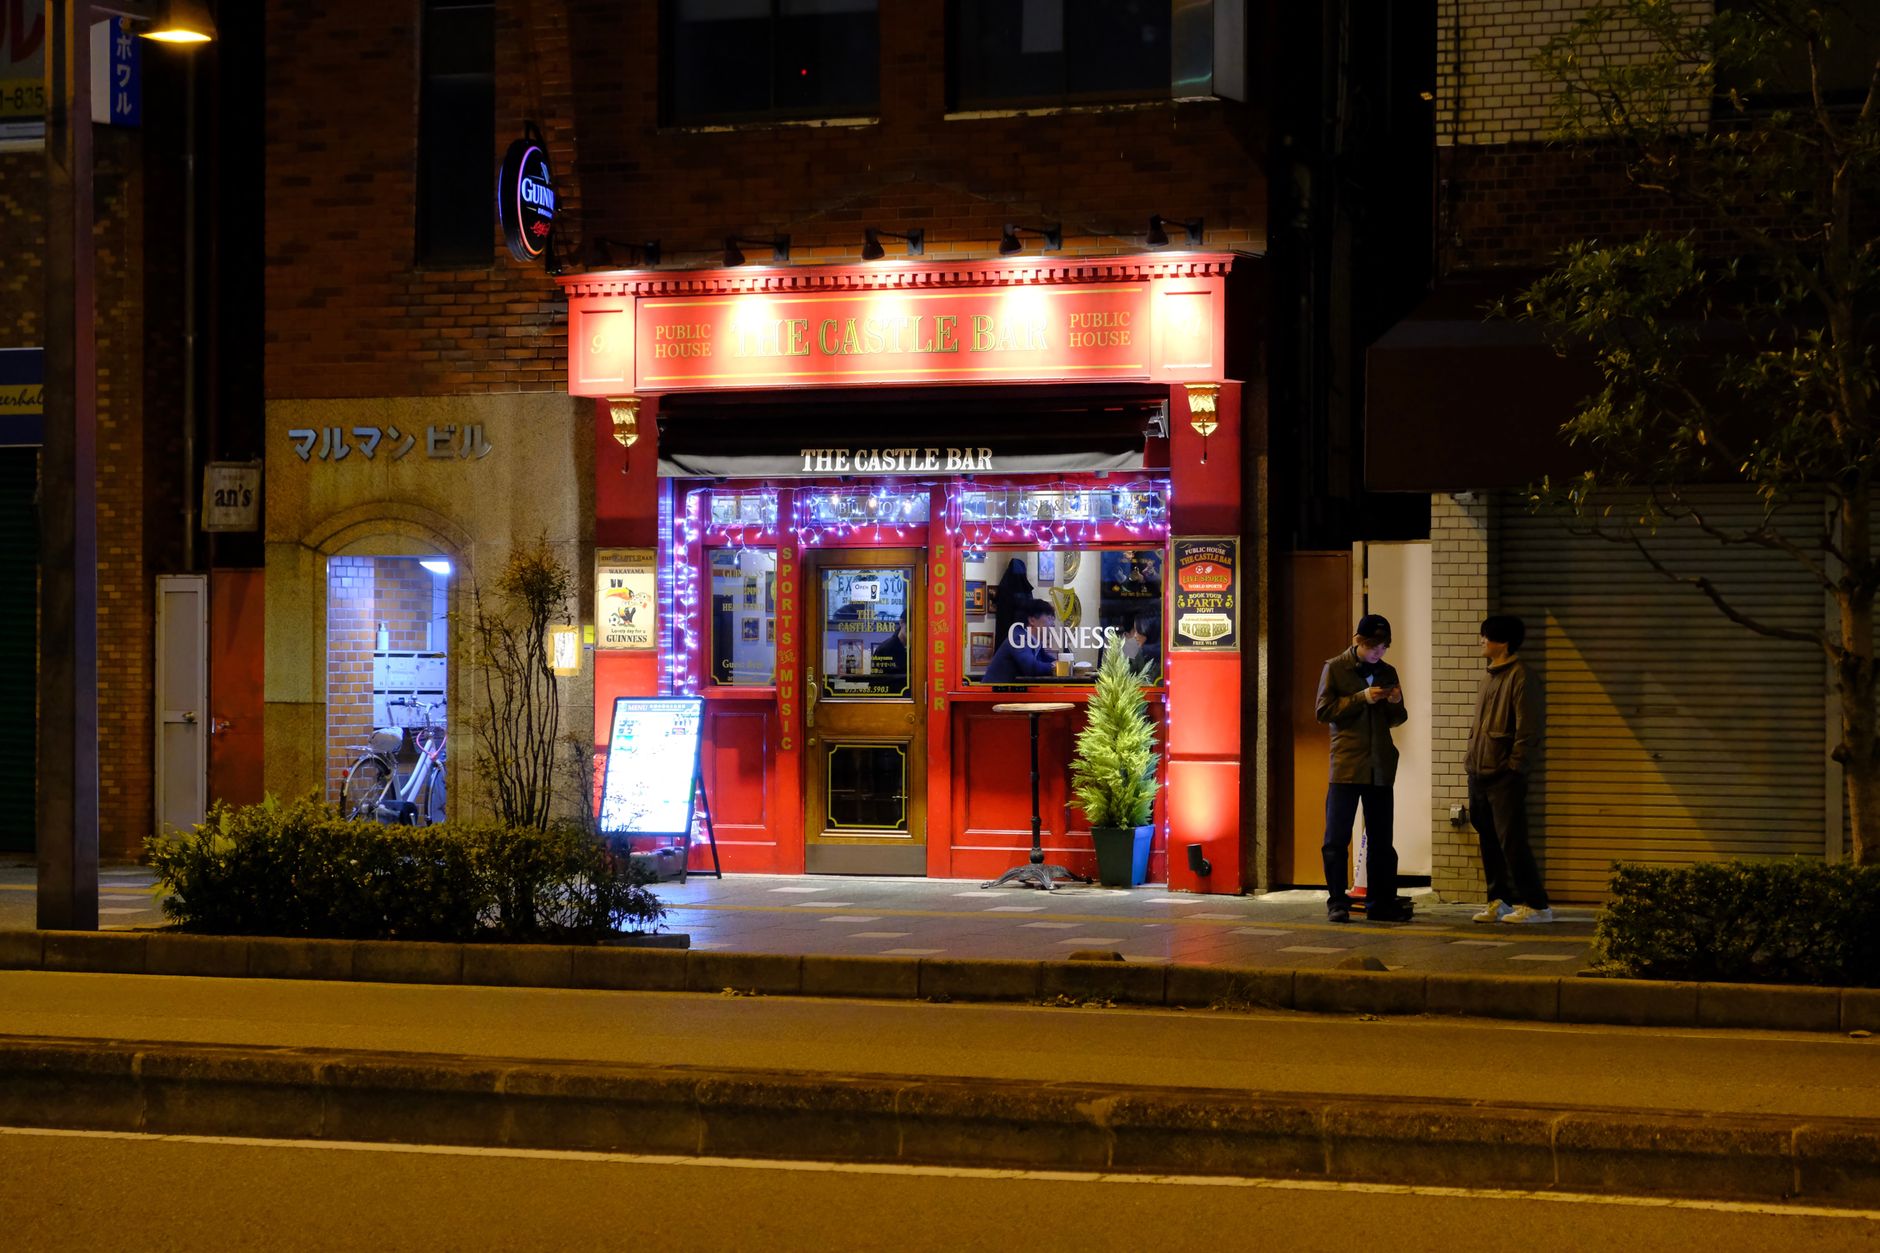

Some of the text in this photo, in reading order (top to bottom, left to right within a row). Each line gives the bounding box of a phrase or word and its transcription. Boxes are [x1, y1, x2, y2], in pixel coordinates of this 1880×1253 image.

[1069, 311, 1131, 329] PUBLIC
[655, 324, 712, 340] PUBLIC
[818, 315, 959, 355] CASTLE
[969, 314, 1049, 352] BAR
[1068, 331, 1131, 348] HOUSE
[655, 342, 712, 359] HOUSE
[800, 447, 993, 472] THE CASTLE BAR
[1185, 546, 1226, 555] PUBLIC HOUSE
[1194, 553, 1219, 562] CASTLE
[934, 545, 946, 614] FOOD
[1183, 575, 1228, 583] LIVE SPORTS
[781, 547, 793, 645] SPORTS
[1187, 598, 1223, 608] PARTY
[838, 621, 896, 632] CASTLE BAR
[606, 634, 648, 643] GUINNESS
[1007, 622, 1116, 649] GUINNESS
[933, 640, 946, 710] BEER
[780, 669, 793, 751] MUSIC
